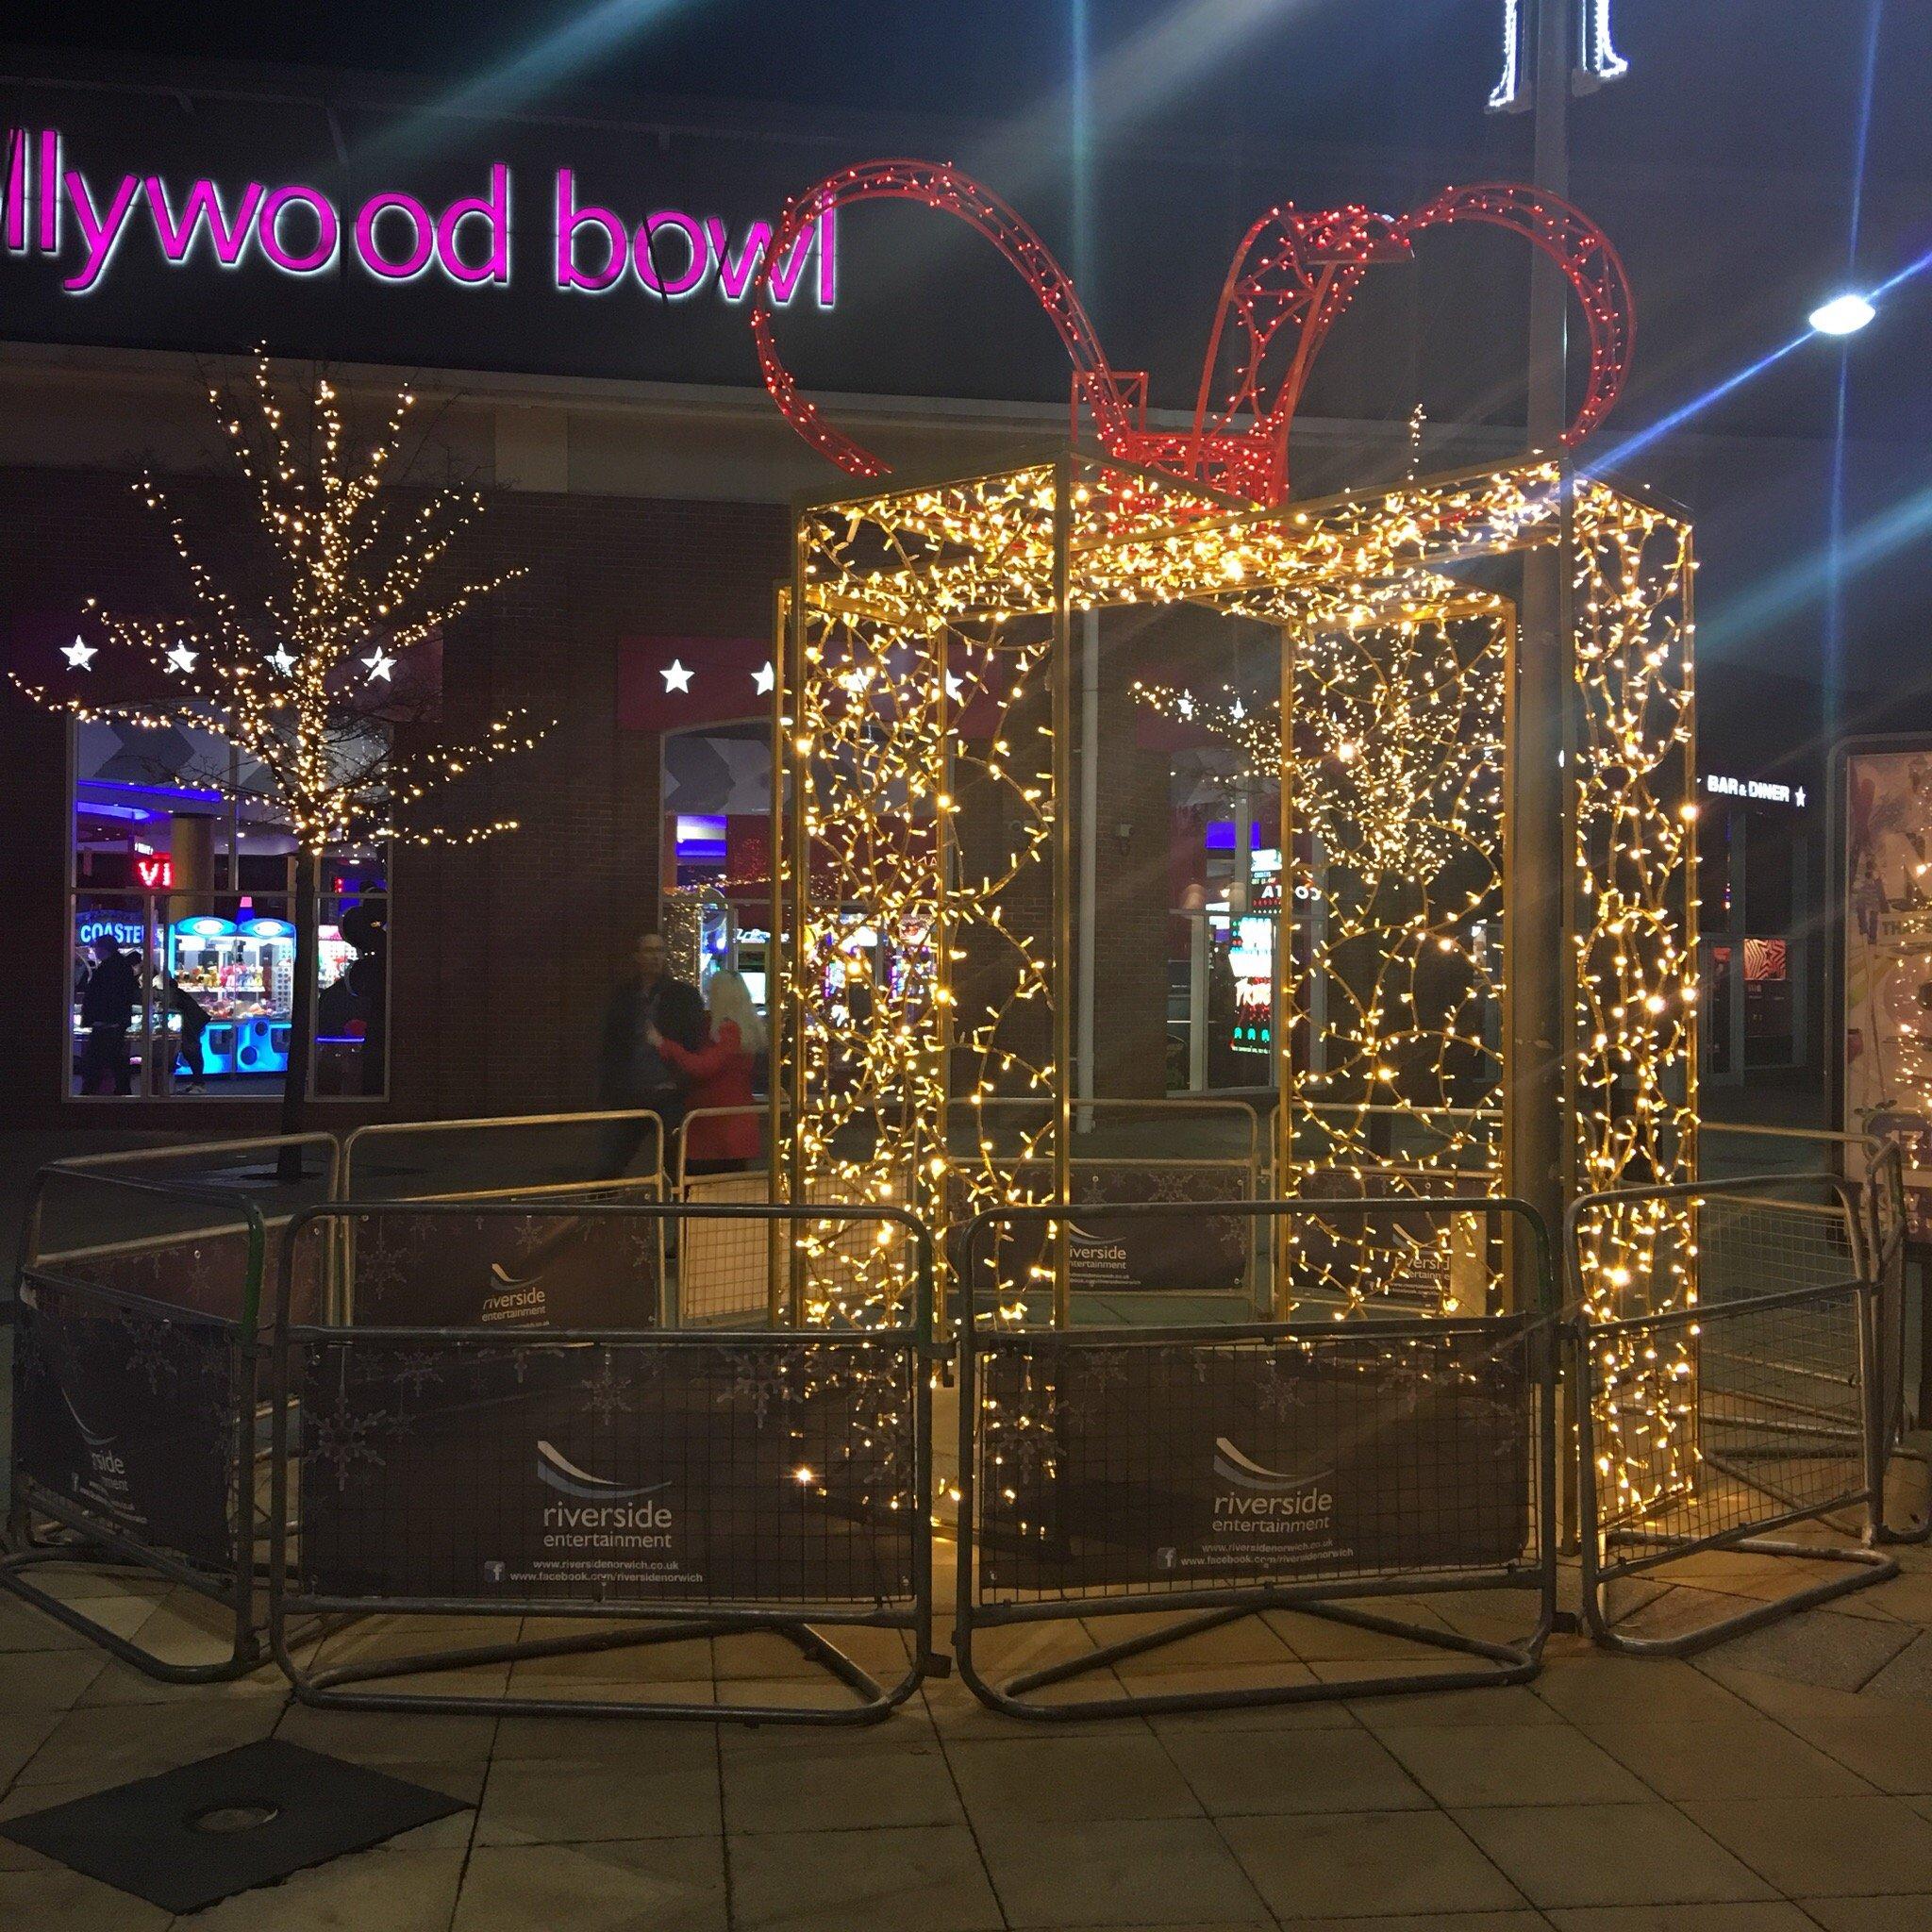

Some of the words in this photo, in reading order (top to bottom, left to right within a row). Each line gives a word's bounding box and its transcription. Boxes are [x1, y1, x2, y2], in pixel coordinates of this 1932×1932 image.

[558, 167, 836, 307] bowl
[1707, 774, 1738, 794] BAR
[1739, 784, 1747, 796] &
[1748, 781, 1790, 802] DINER
[80, 923, 144, 943] COASTE
[1069, 1245, 1126, 1259] iverside
[482, 1287, 545, 1310] riverside
[481, 1306, 546, 1322] entertainment
[1213, 1488, 1333, 1515] riverside
[543, 1500, 673, 1528] riverside
[1212, 1516, 1330, 1533] entertainment
[543, 1531, 673, 1548] entertainment
[533, 1559, 679, 1571] www.riversidenorwich.co.uk
